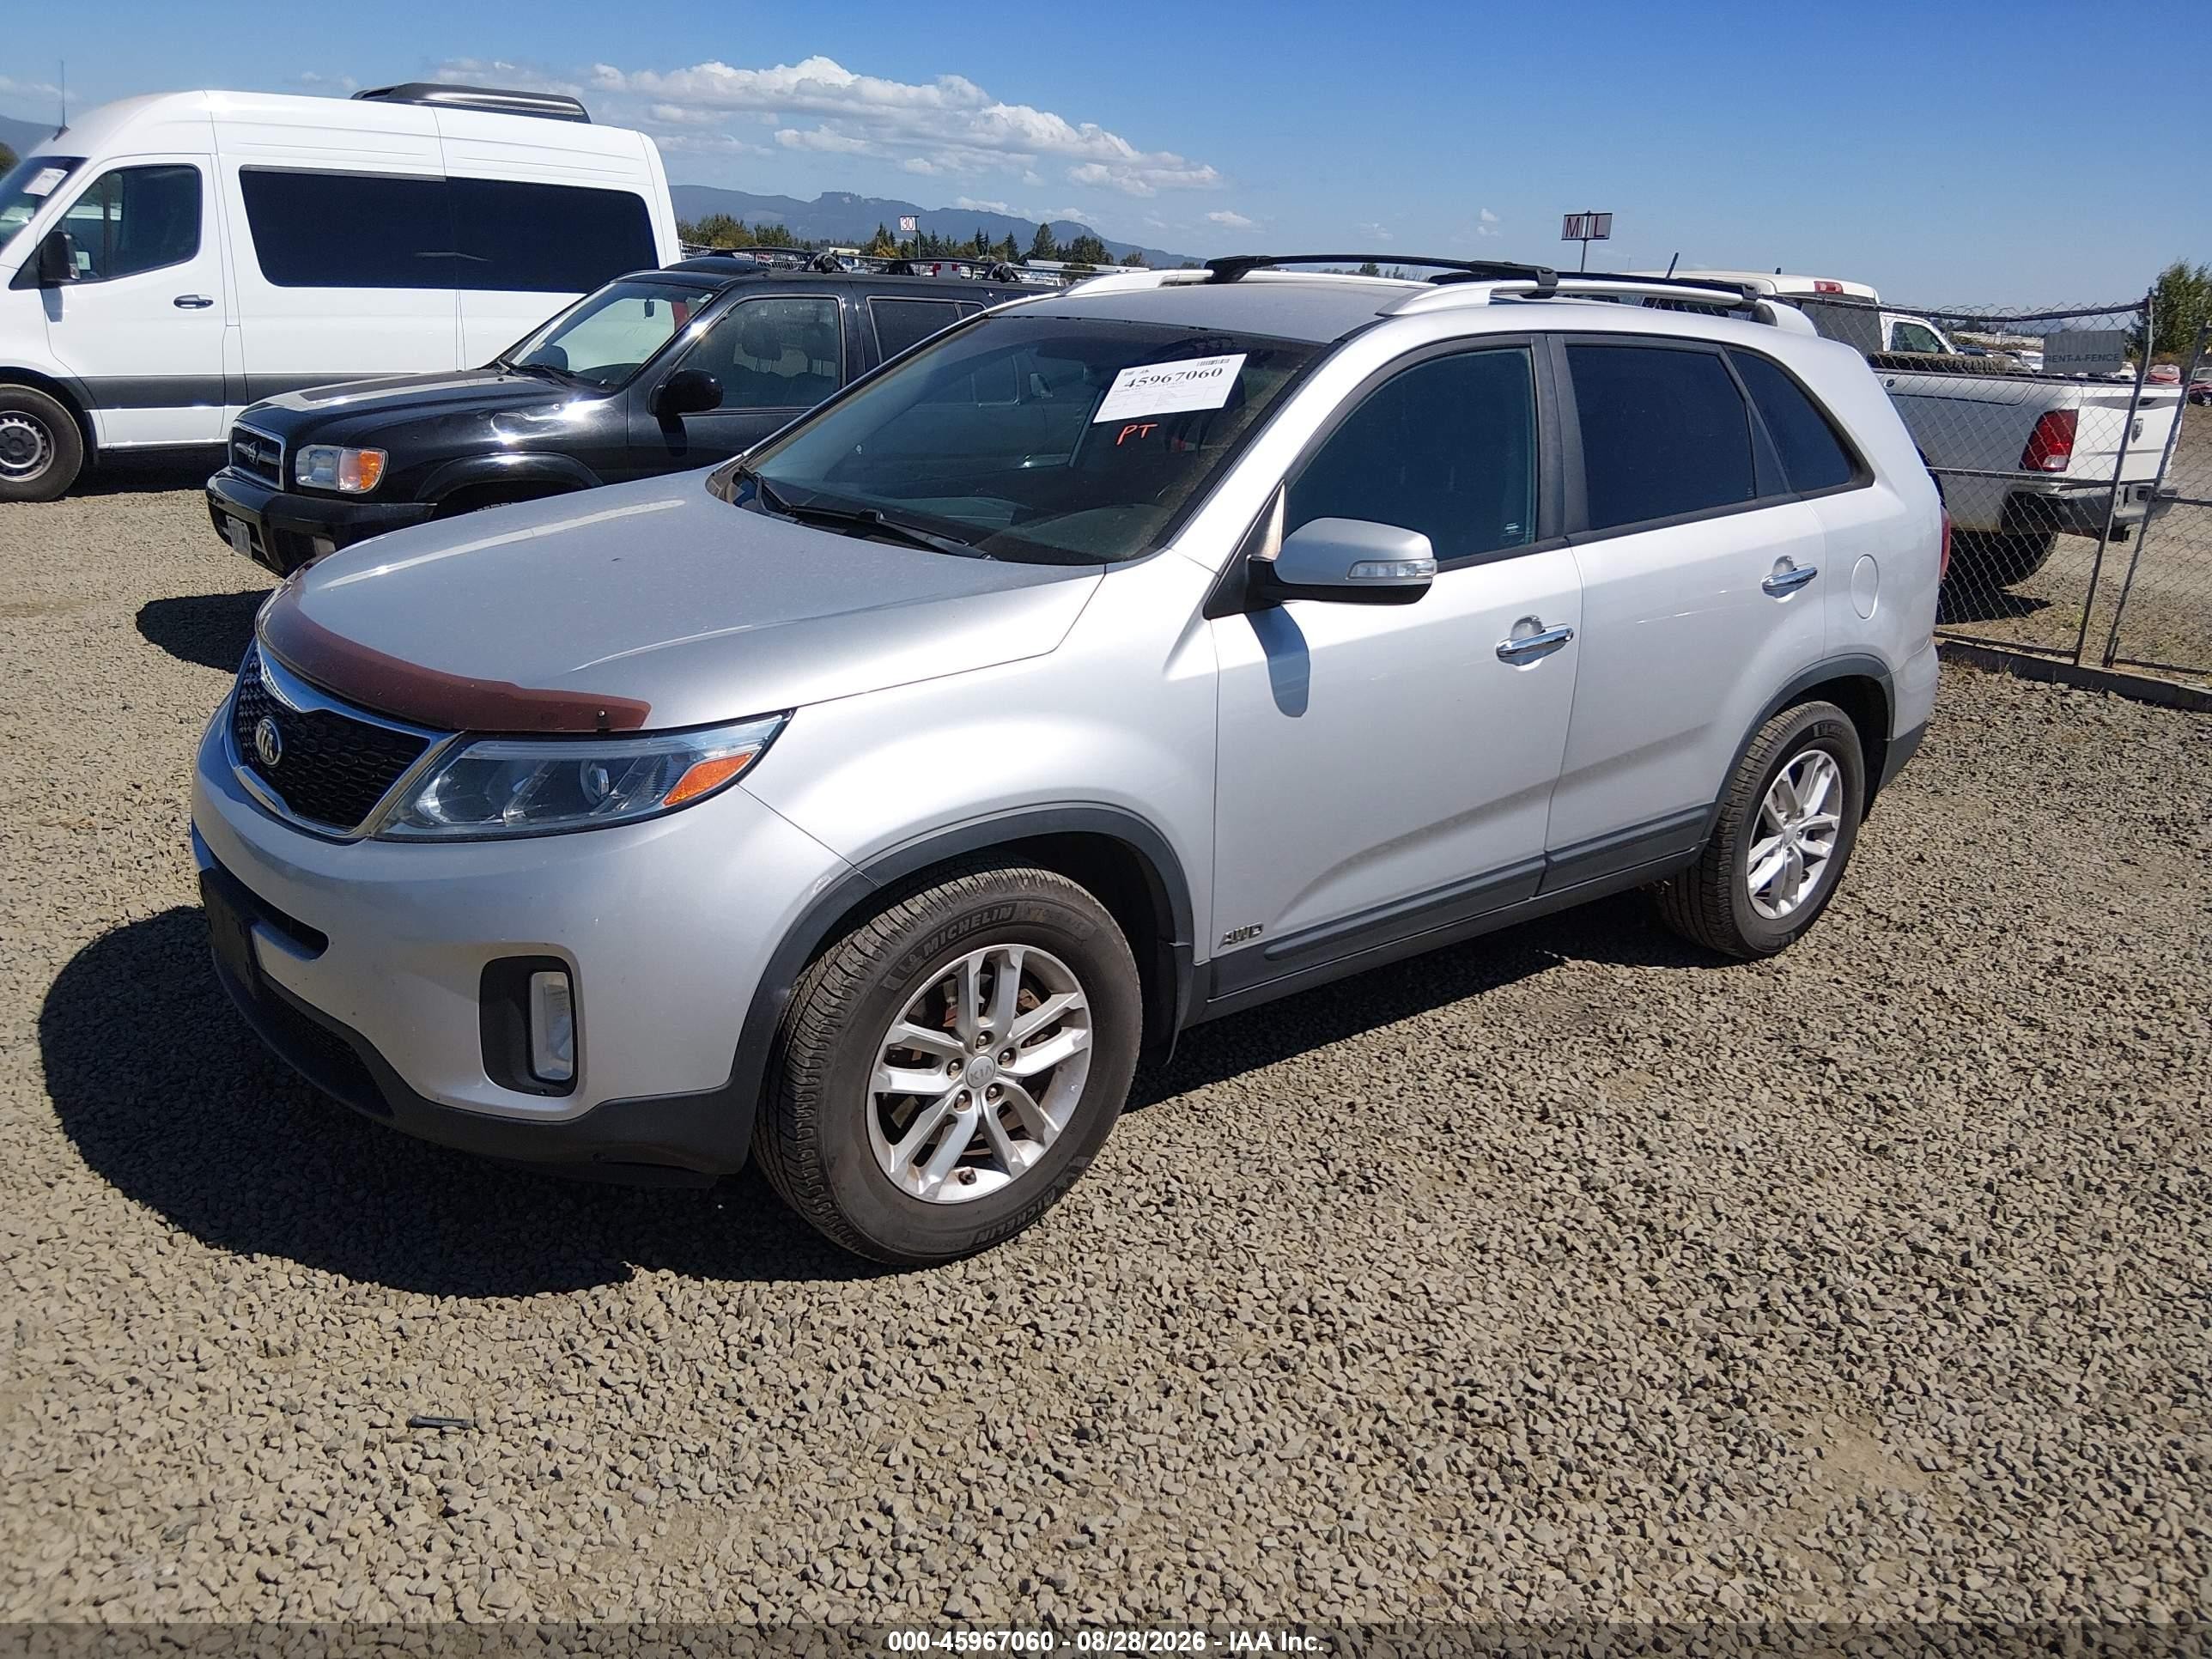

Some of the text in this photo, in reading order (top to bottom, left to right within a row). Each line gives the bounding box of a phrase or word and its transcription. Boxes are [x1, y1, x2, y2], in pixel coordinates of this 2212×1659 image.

[902, 217, 914, 230] 30
[2045, 353, 2120, 362] RENT-A-FENCE
[1124, 368, 1223, 388] 45967060
[1116, 423, 1158, 446] PT
[923, 906, 1013, 957] MICHELIN
[970, 1065, 993, 1083] KIA
